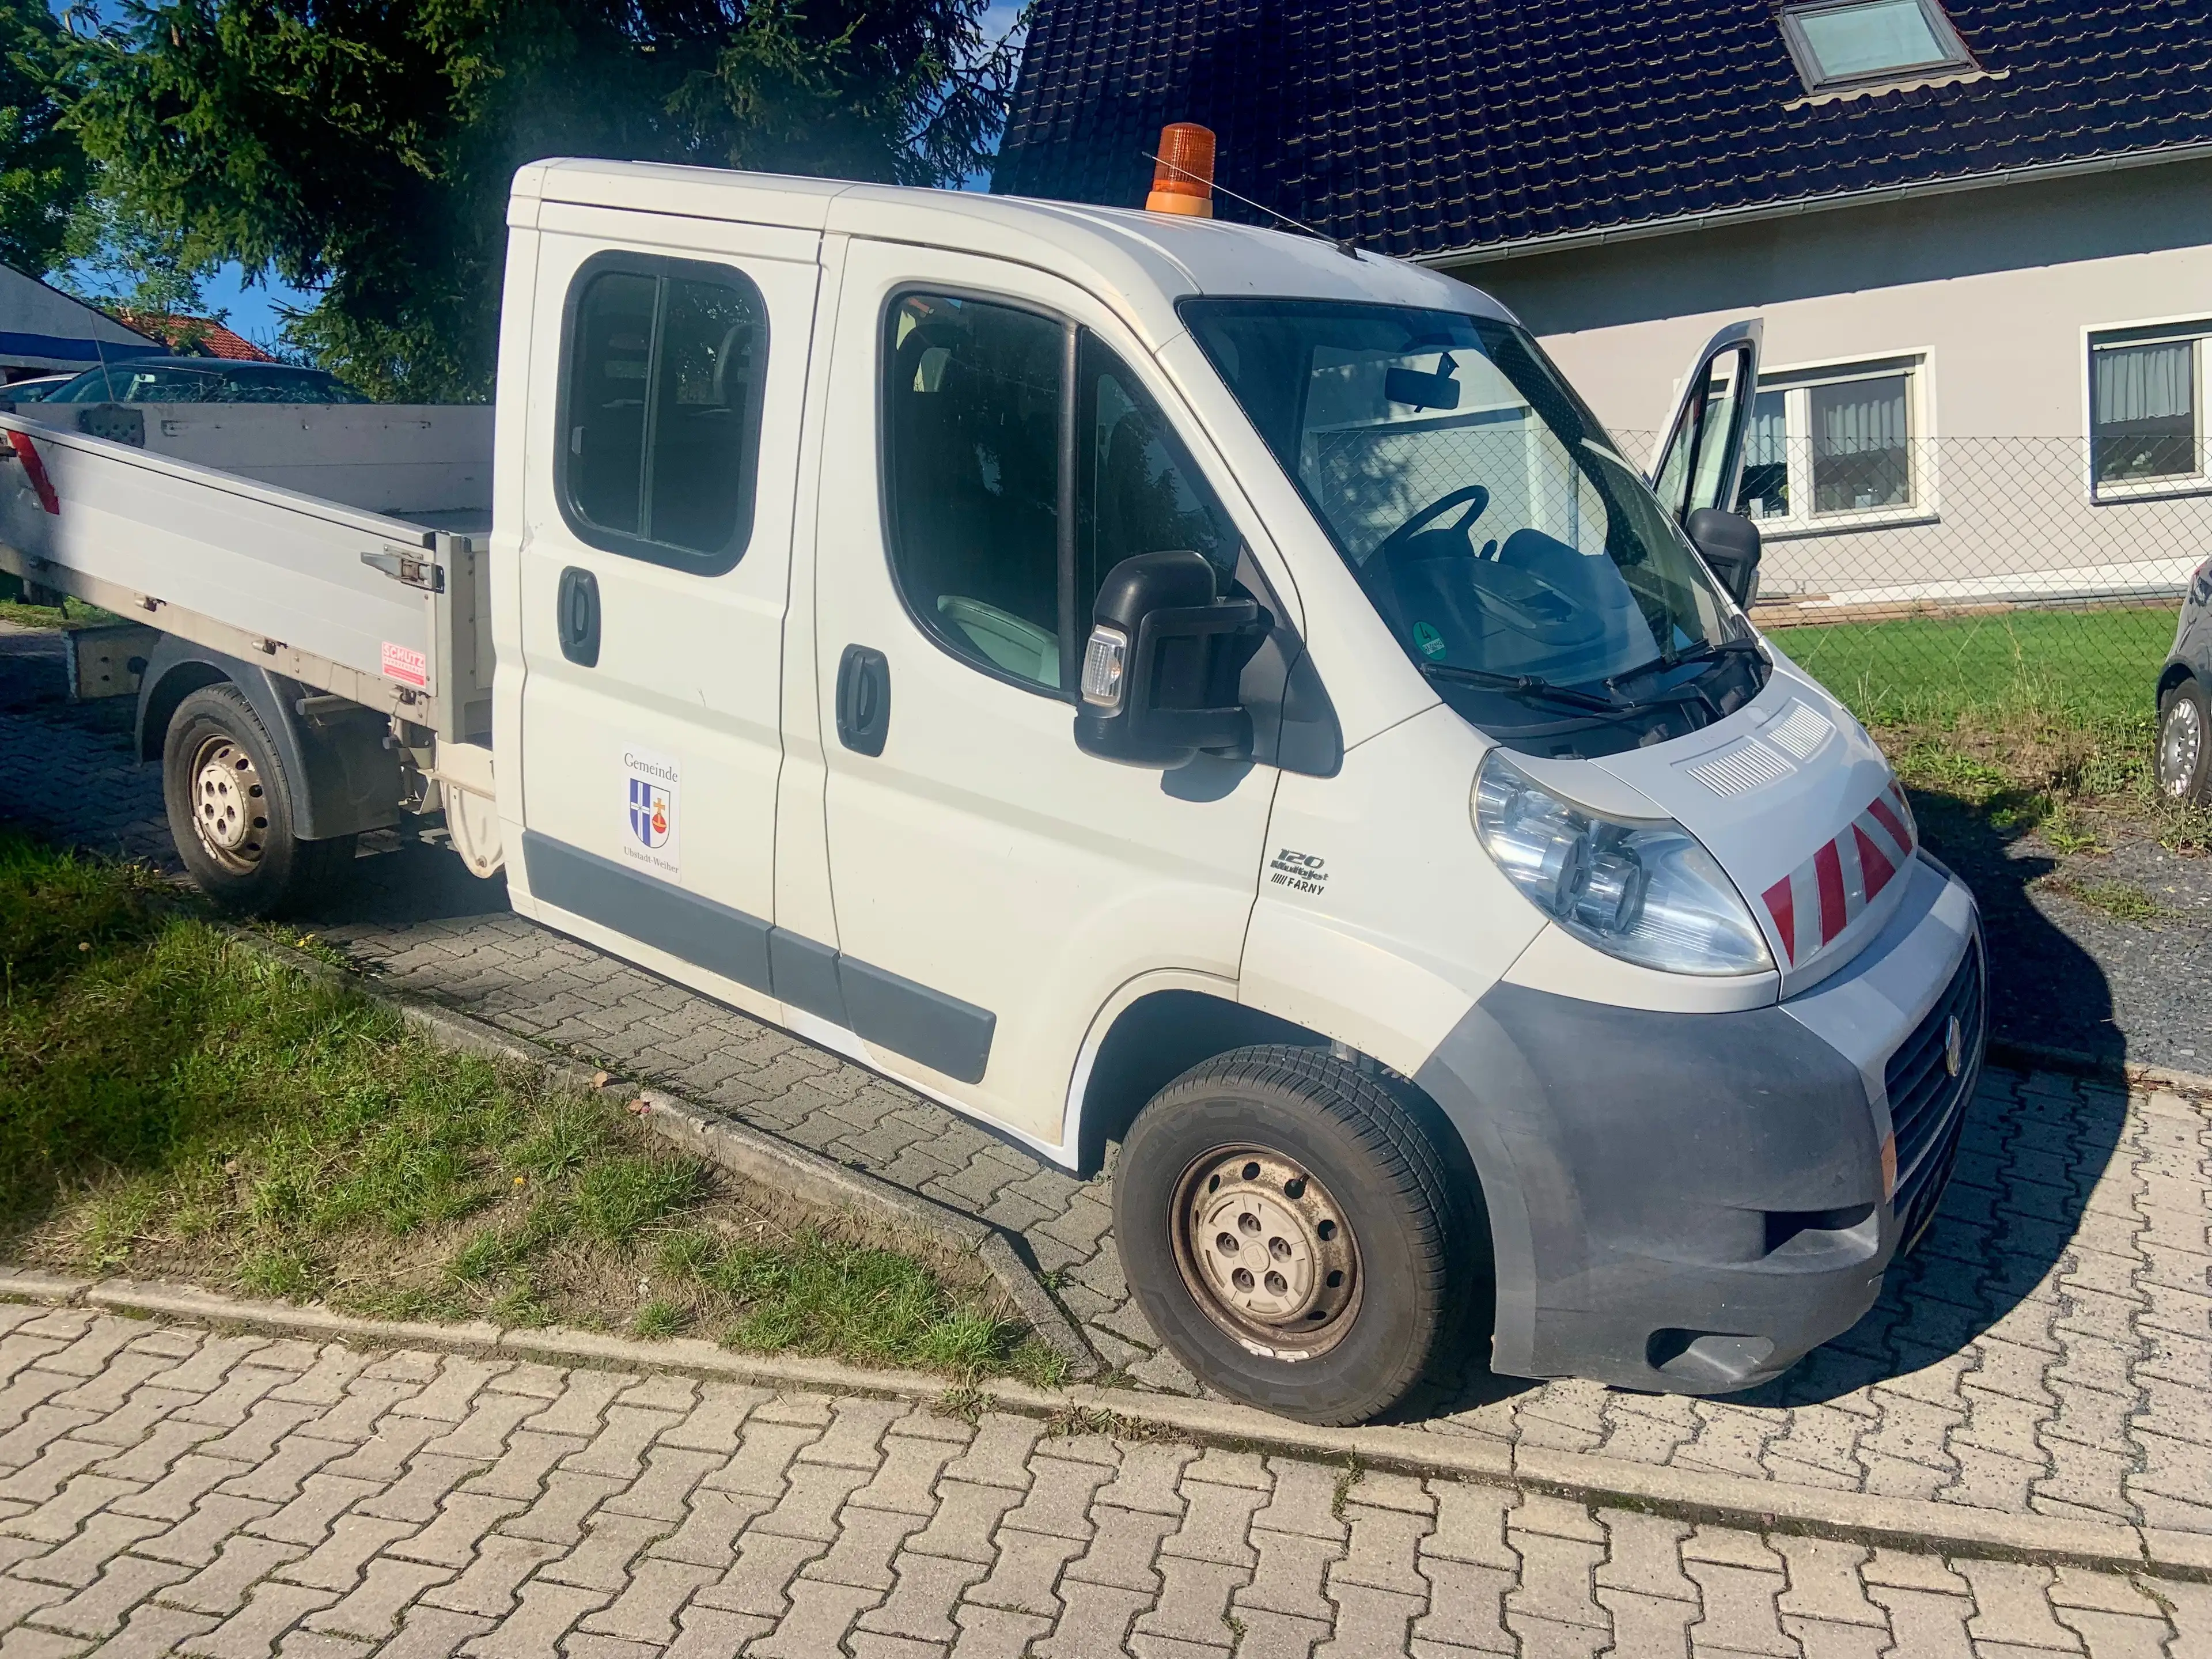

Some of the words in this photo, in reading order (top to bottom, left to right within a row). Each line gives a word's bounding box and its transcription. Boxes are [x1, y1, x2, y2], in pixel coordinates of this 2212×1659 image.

[624, 752, 678, 782] Gemeinde
[624, 846, 679, 874] Ubstadt-Weiher
[1277, 848, 1325, 869] 120
[1287, 877, 1325, 896] FARNY
